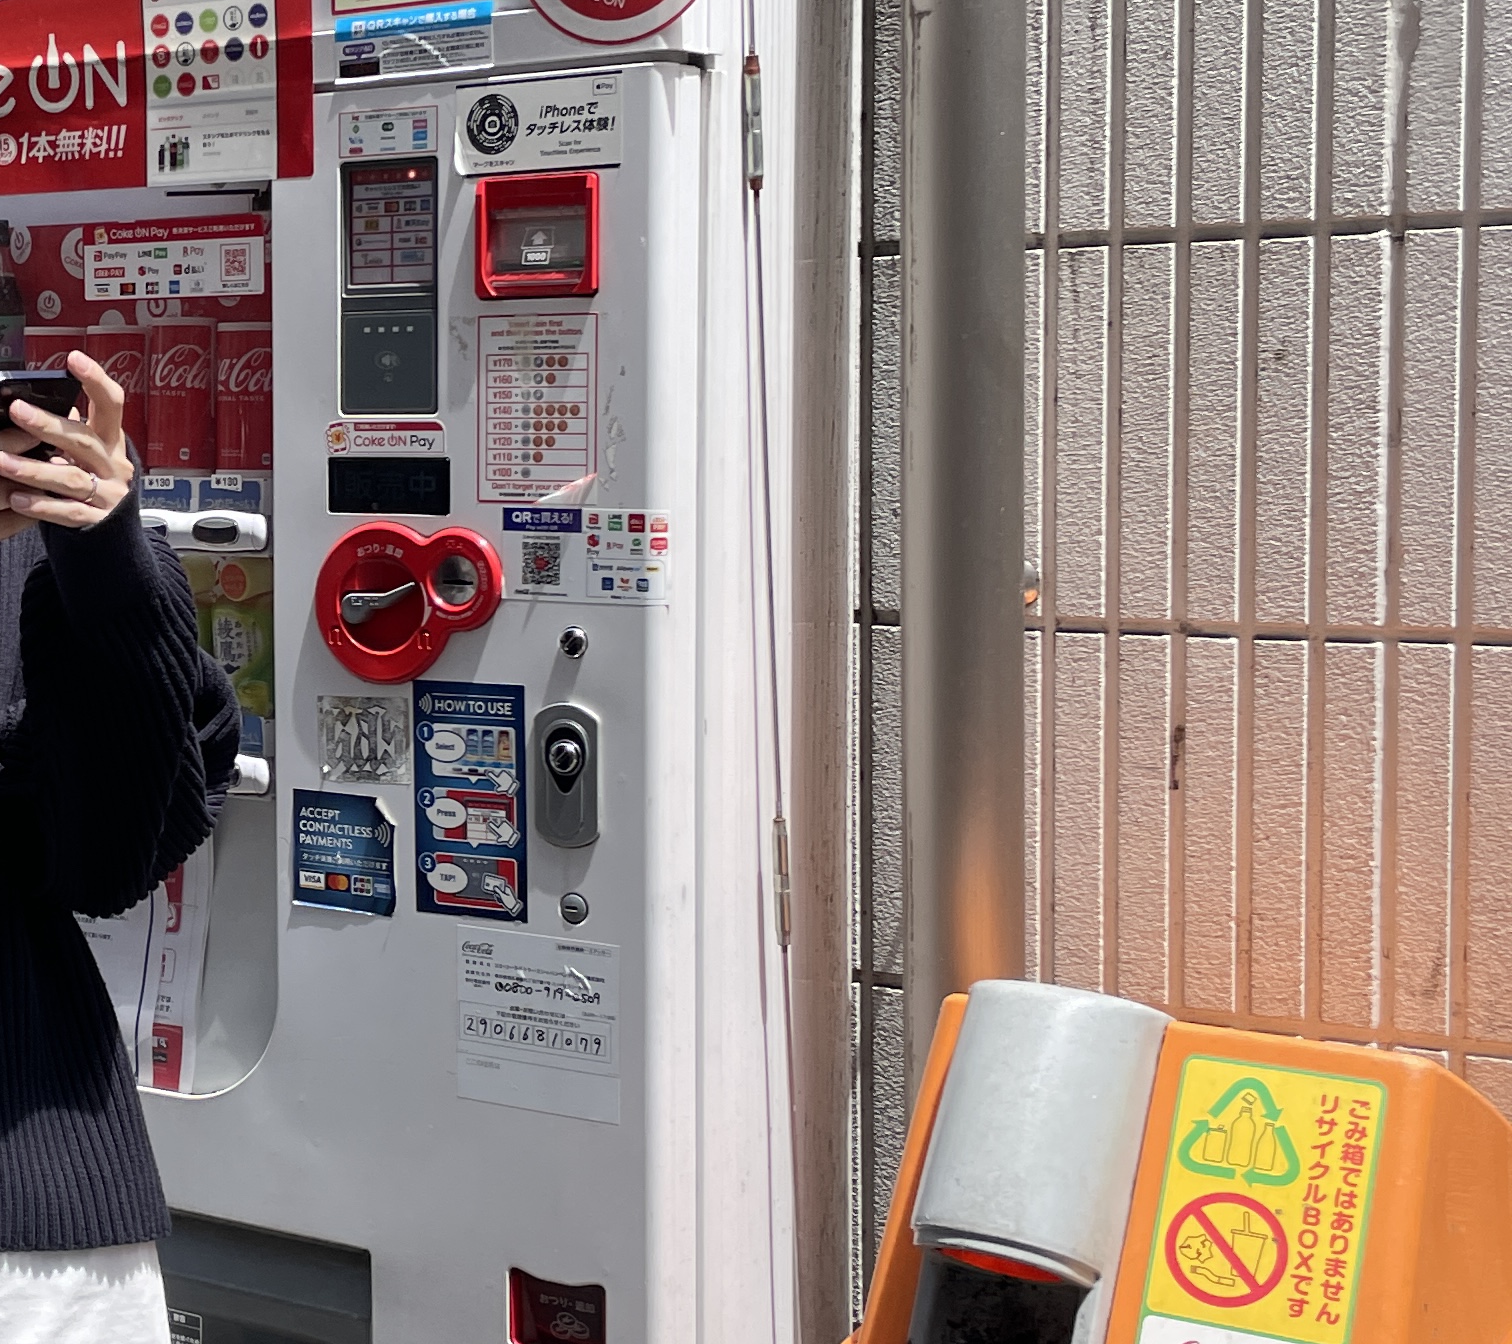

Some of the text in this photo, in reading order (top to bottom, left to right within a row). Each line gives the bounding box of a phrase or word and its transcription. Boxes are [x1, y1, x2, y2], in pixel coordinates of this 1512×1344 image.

[539, 101, 599, 119] iPhoneで
[525, 116, 616, 137] タッチレス体験!
[110, 229, 133, 239] Coke
[151, 227, 169, 239] Pay
[104, 251, 127, 261] PayPay
[190, 246, 204, 256] Pay
[527, 252, 546, 261] 1000
[148, 266, 159, 275] Pay
[354, 433, 435, 450] Coke ON Pay
[148, 477, 170, 488] ¥130
[215, 476, 238, 487] ¥130
[512, 483, 534, 491] forget
[511, 511, 574, 524] QRで買える!
[434, 699, 513, 715] HOW TO USE
[423, 793, 430, 804] 2
[299, 806, 341, 820] ACCEPT
[437, 808, 456, 817] Press
[299, 820, 373, 838] CONTACTLESS
[299, 833, 353, 849] PAYMENTS
[425, 857, 431, 869] 3
[304, 873, 322, 884] VISA
[1287, 1094, 1340, 1318] リサイクルBOXです
[1315, 1099, 1371, 1326] ごみ箱ではありません
